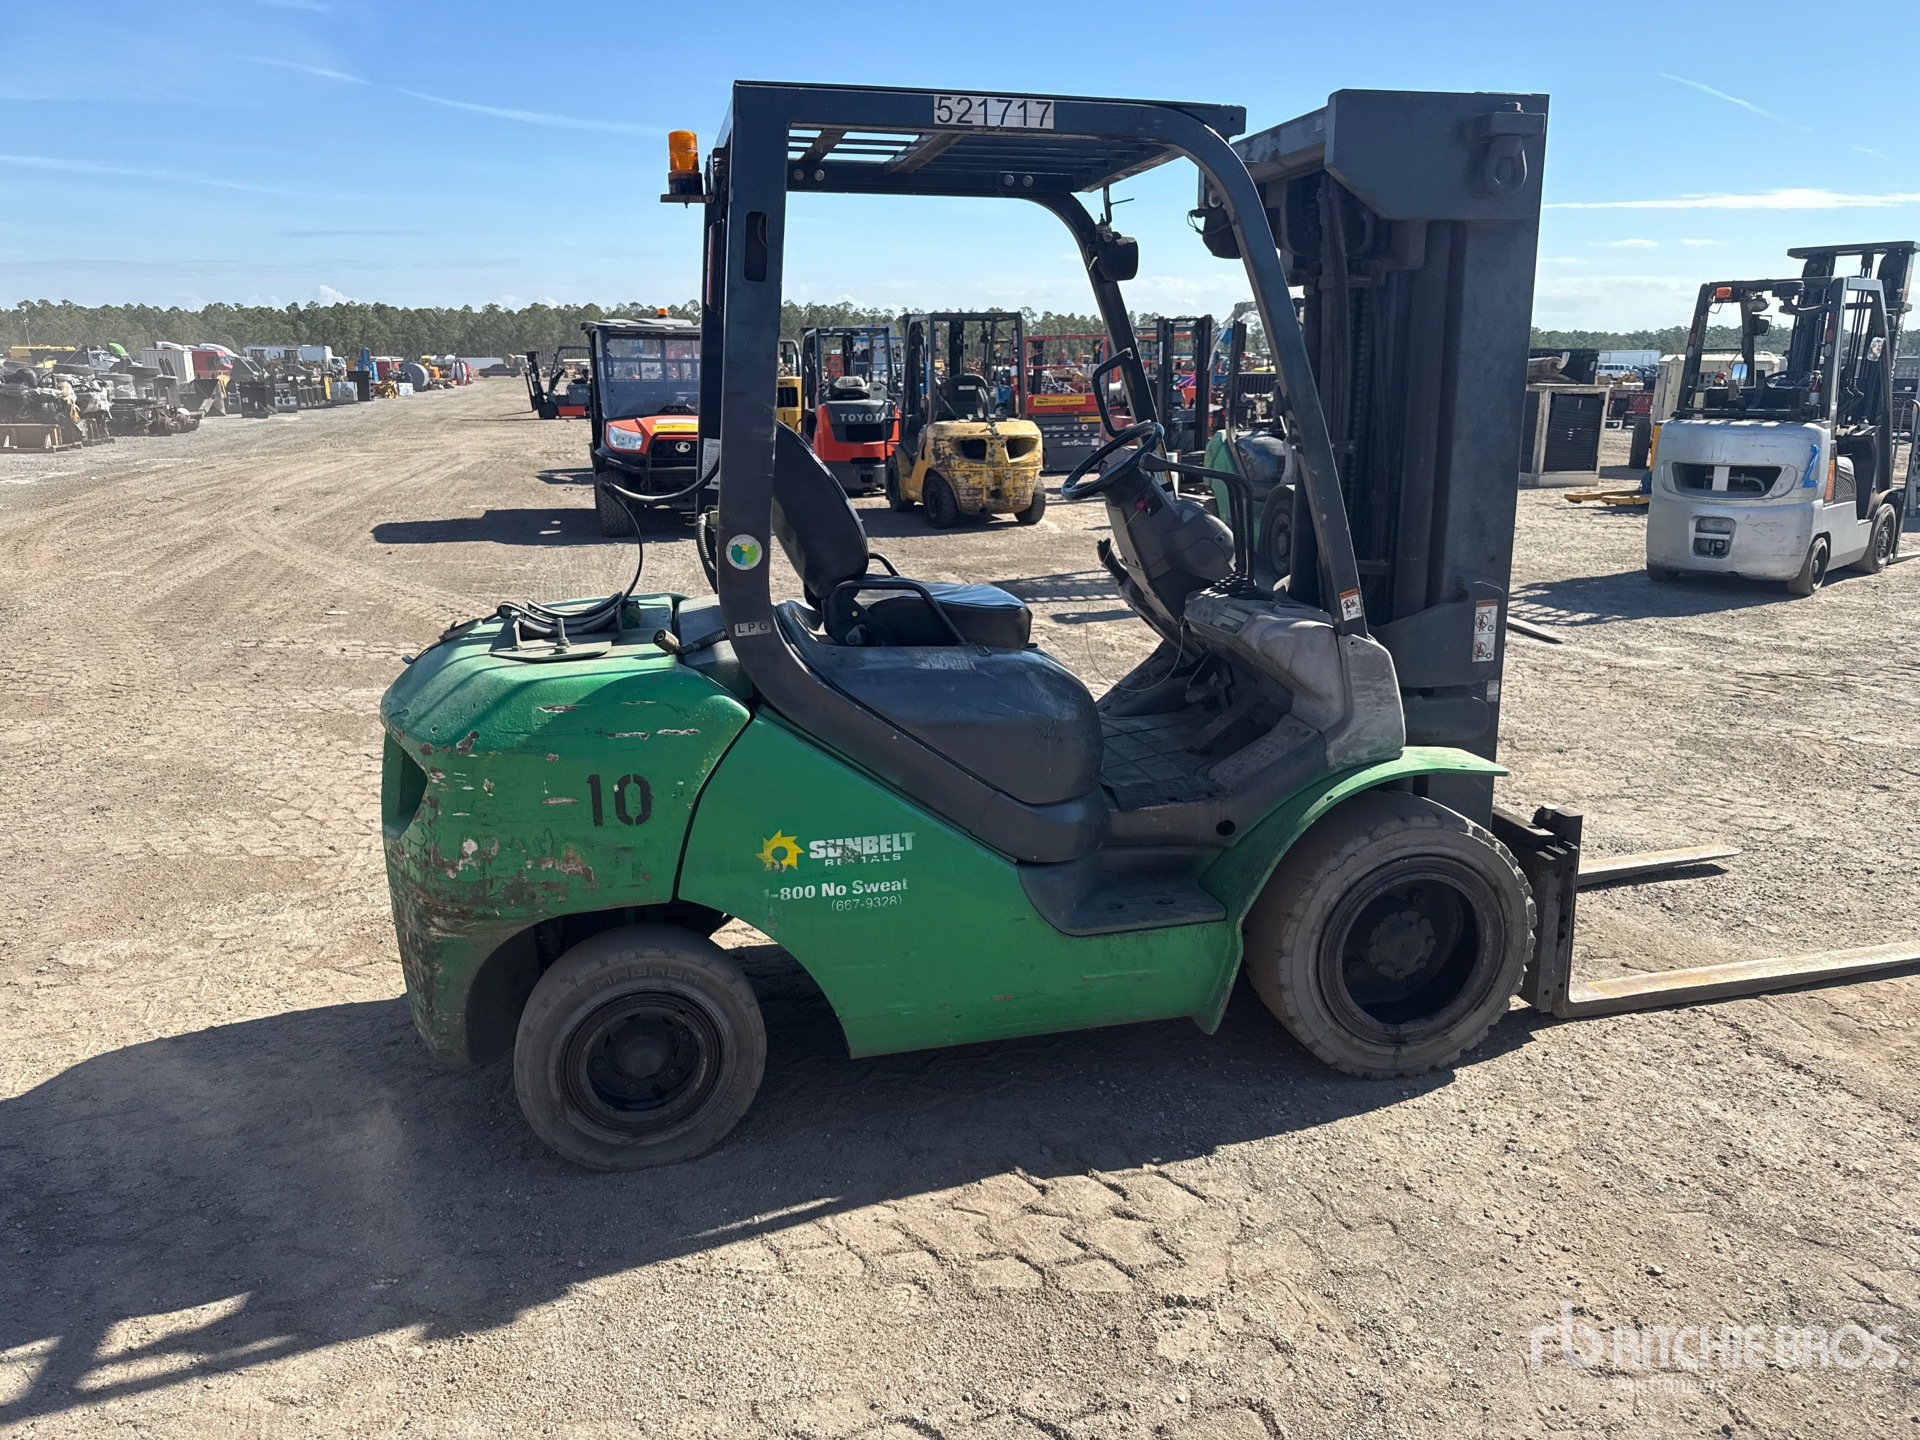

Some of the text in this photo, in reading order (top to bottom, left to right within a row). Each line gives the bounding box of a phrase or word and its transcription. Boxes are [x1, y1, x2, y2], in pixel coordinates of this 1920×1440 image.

[936, 96, 1052, 127] 521717
[840, 413, 885, 422] TOYOTA
[586, 773, 652, 827] 10
[809, 832, 916, 859] SUNBELT
[821, 882, 847, 897] No
[852, 878, 909, 895] Sweat
[831, 893, 903, 912] (667-9328)
[594, 964, 700, 990] MAGNUM
